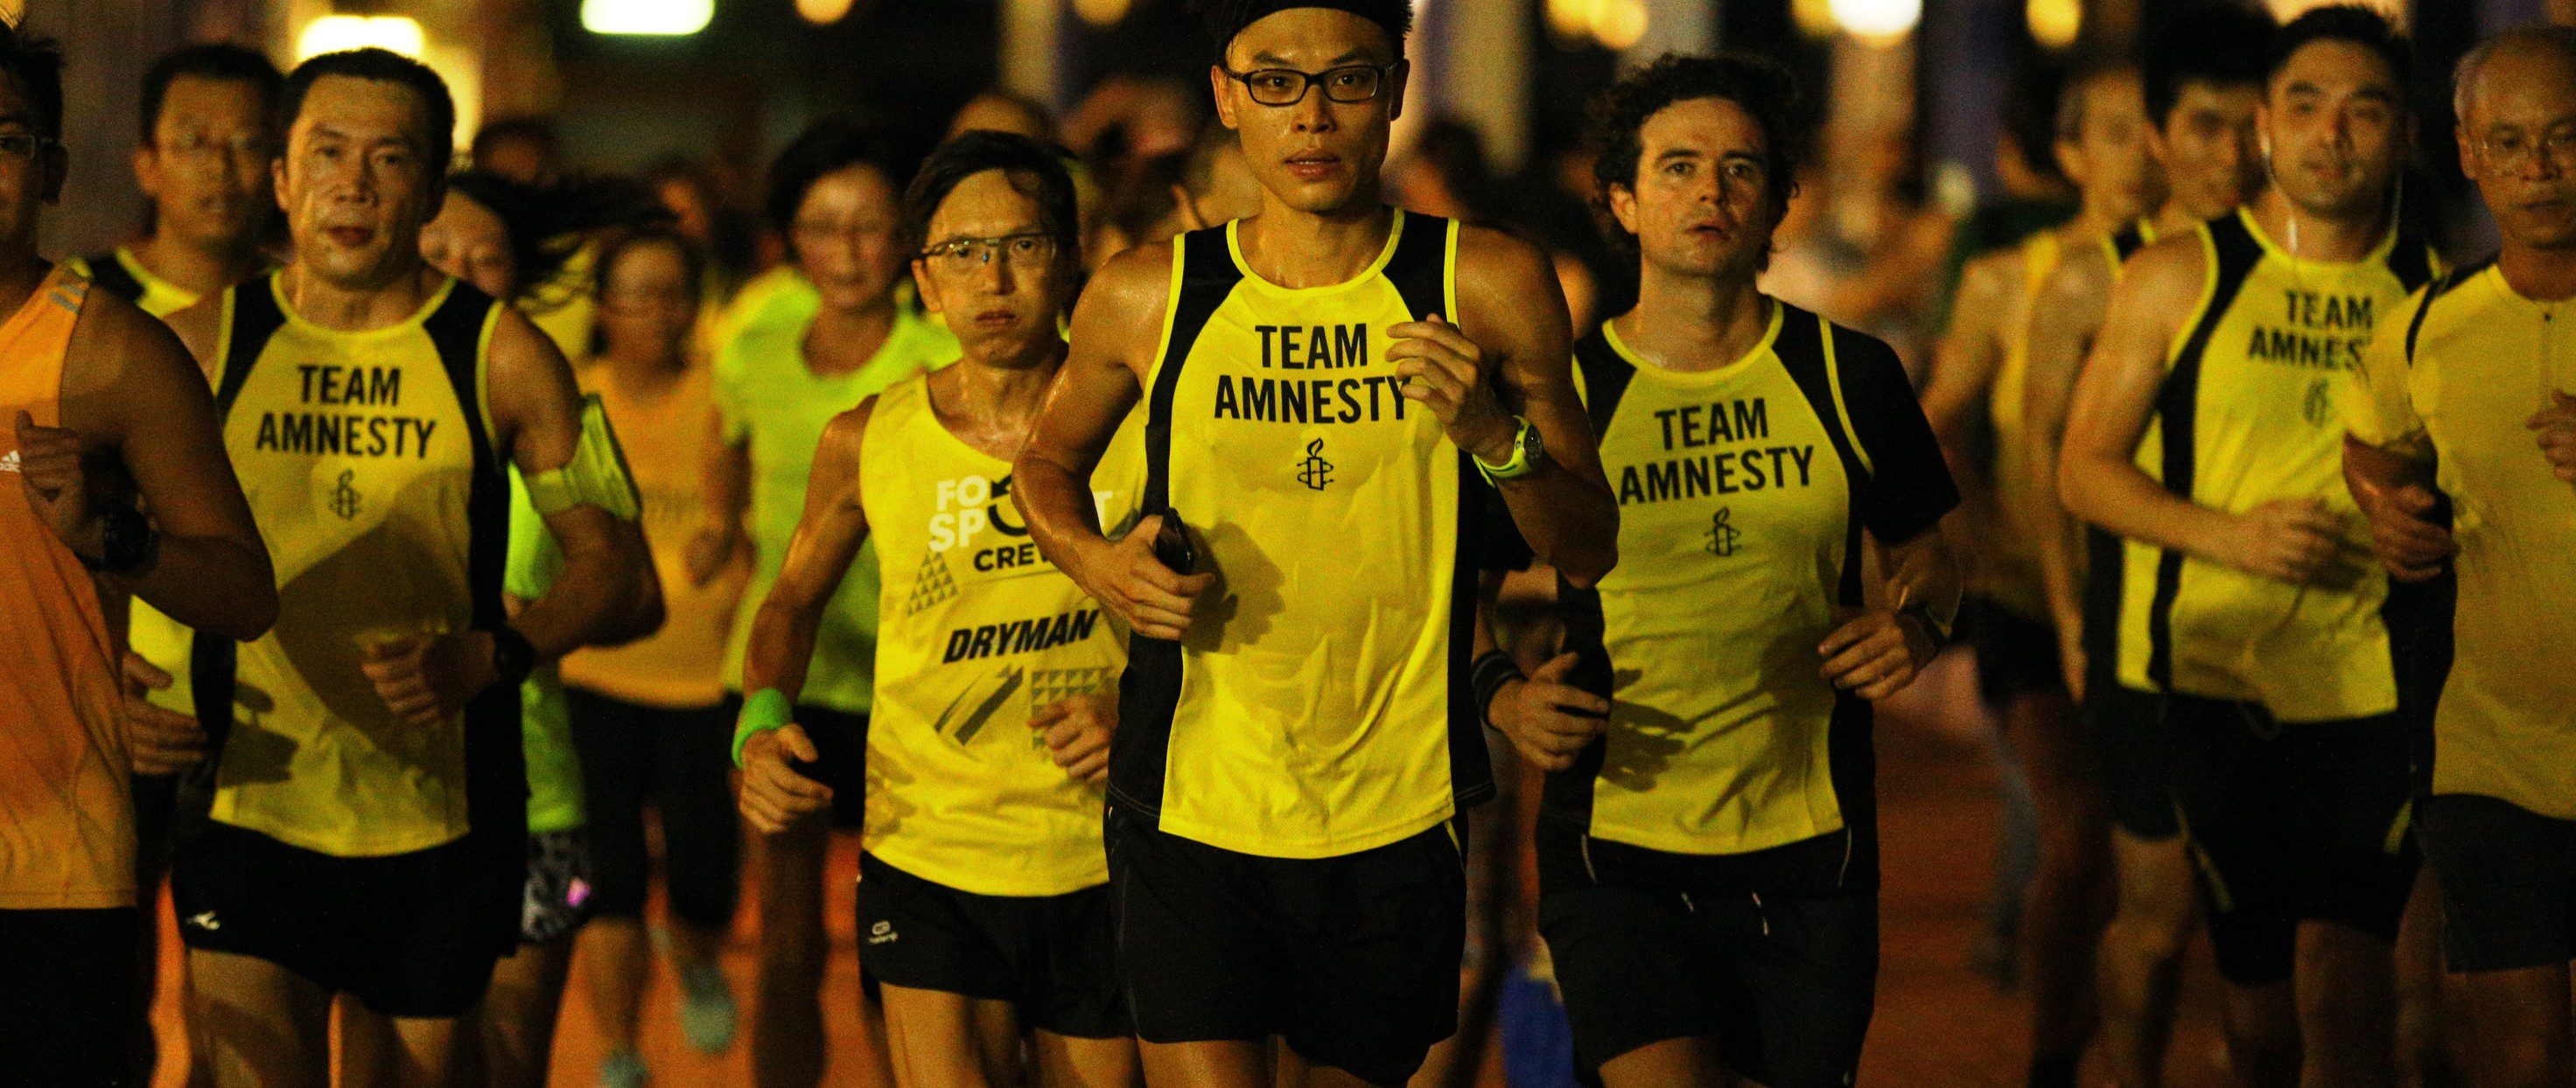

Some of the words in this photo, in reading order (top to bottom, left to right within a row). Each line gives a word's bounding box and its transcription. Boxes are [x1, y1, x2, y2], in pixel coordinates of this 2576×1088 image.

[2286, 290, 2372, 329] TEAM
[1255, 324, 1368, 369] TEAM
[2248, 325, 2370, 370] AMNES
[299, 365, 399, 406] TEAM
[1214, 375, 1411, 423] AMNESTY
[257, 413, 437, 458] AMNESTY
[1655, 398, 1768, 450] TEAM
[1620, 445, 1814, 506] AMNESTY
[974, 542, 1051, 572] CRE
[943, 609, 1099, 664] DRYMAN
